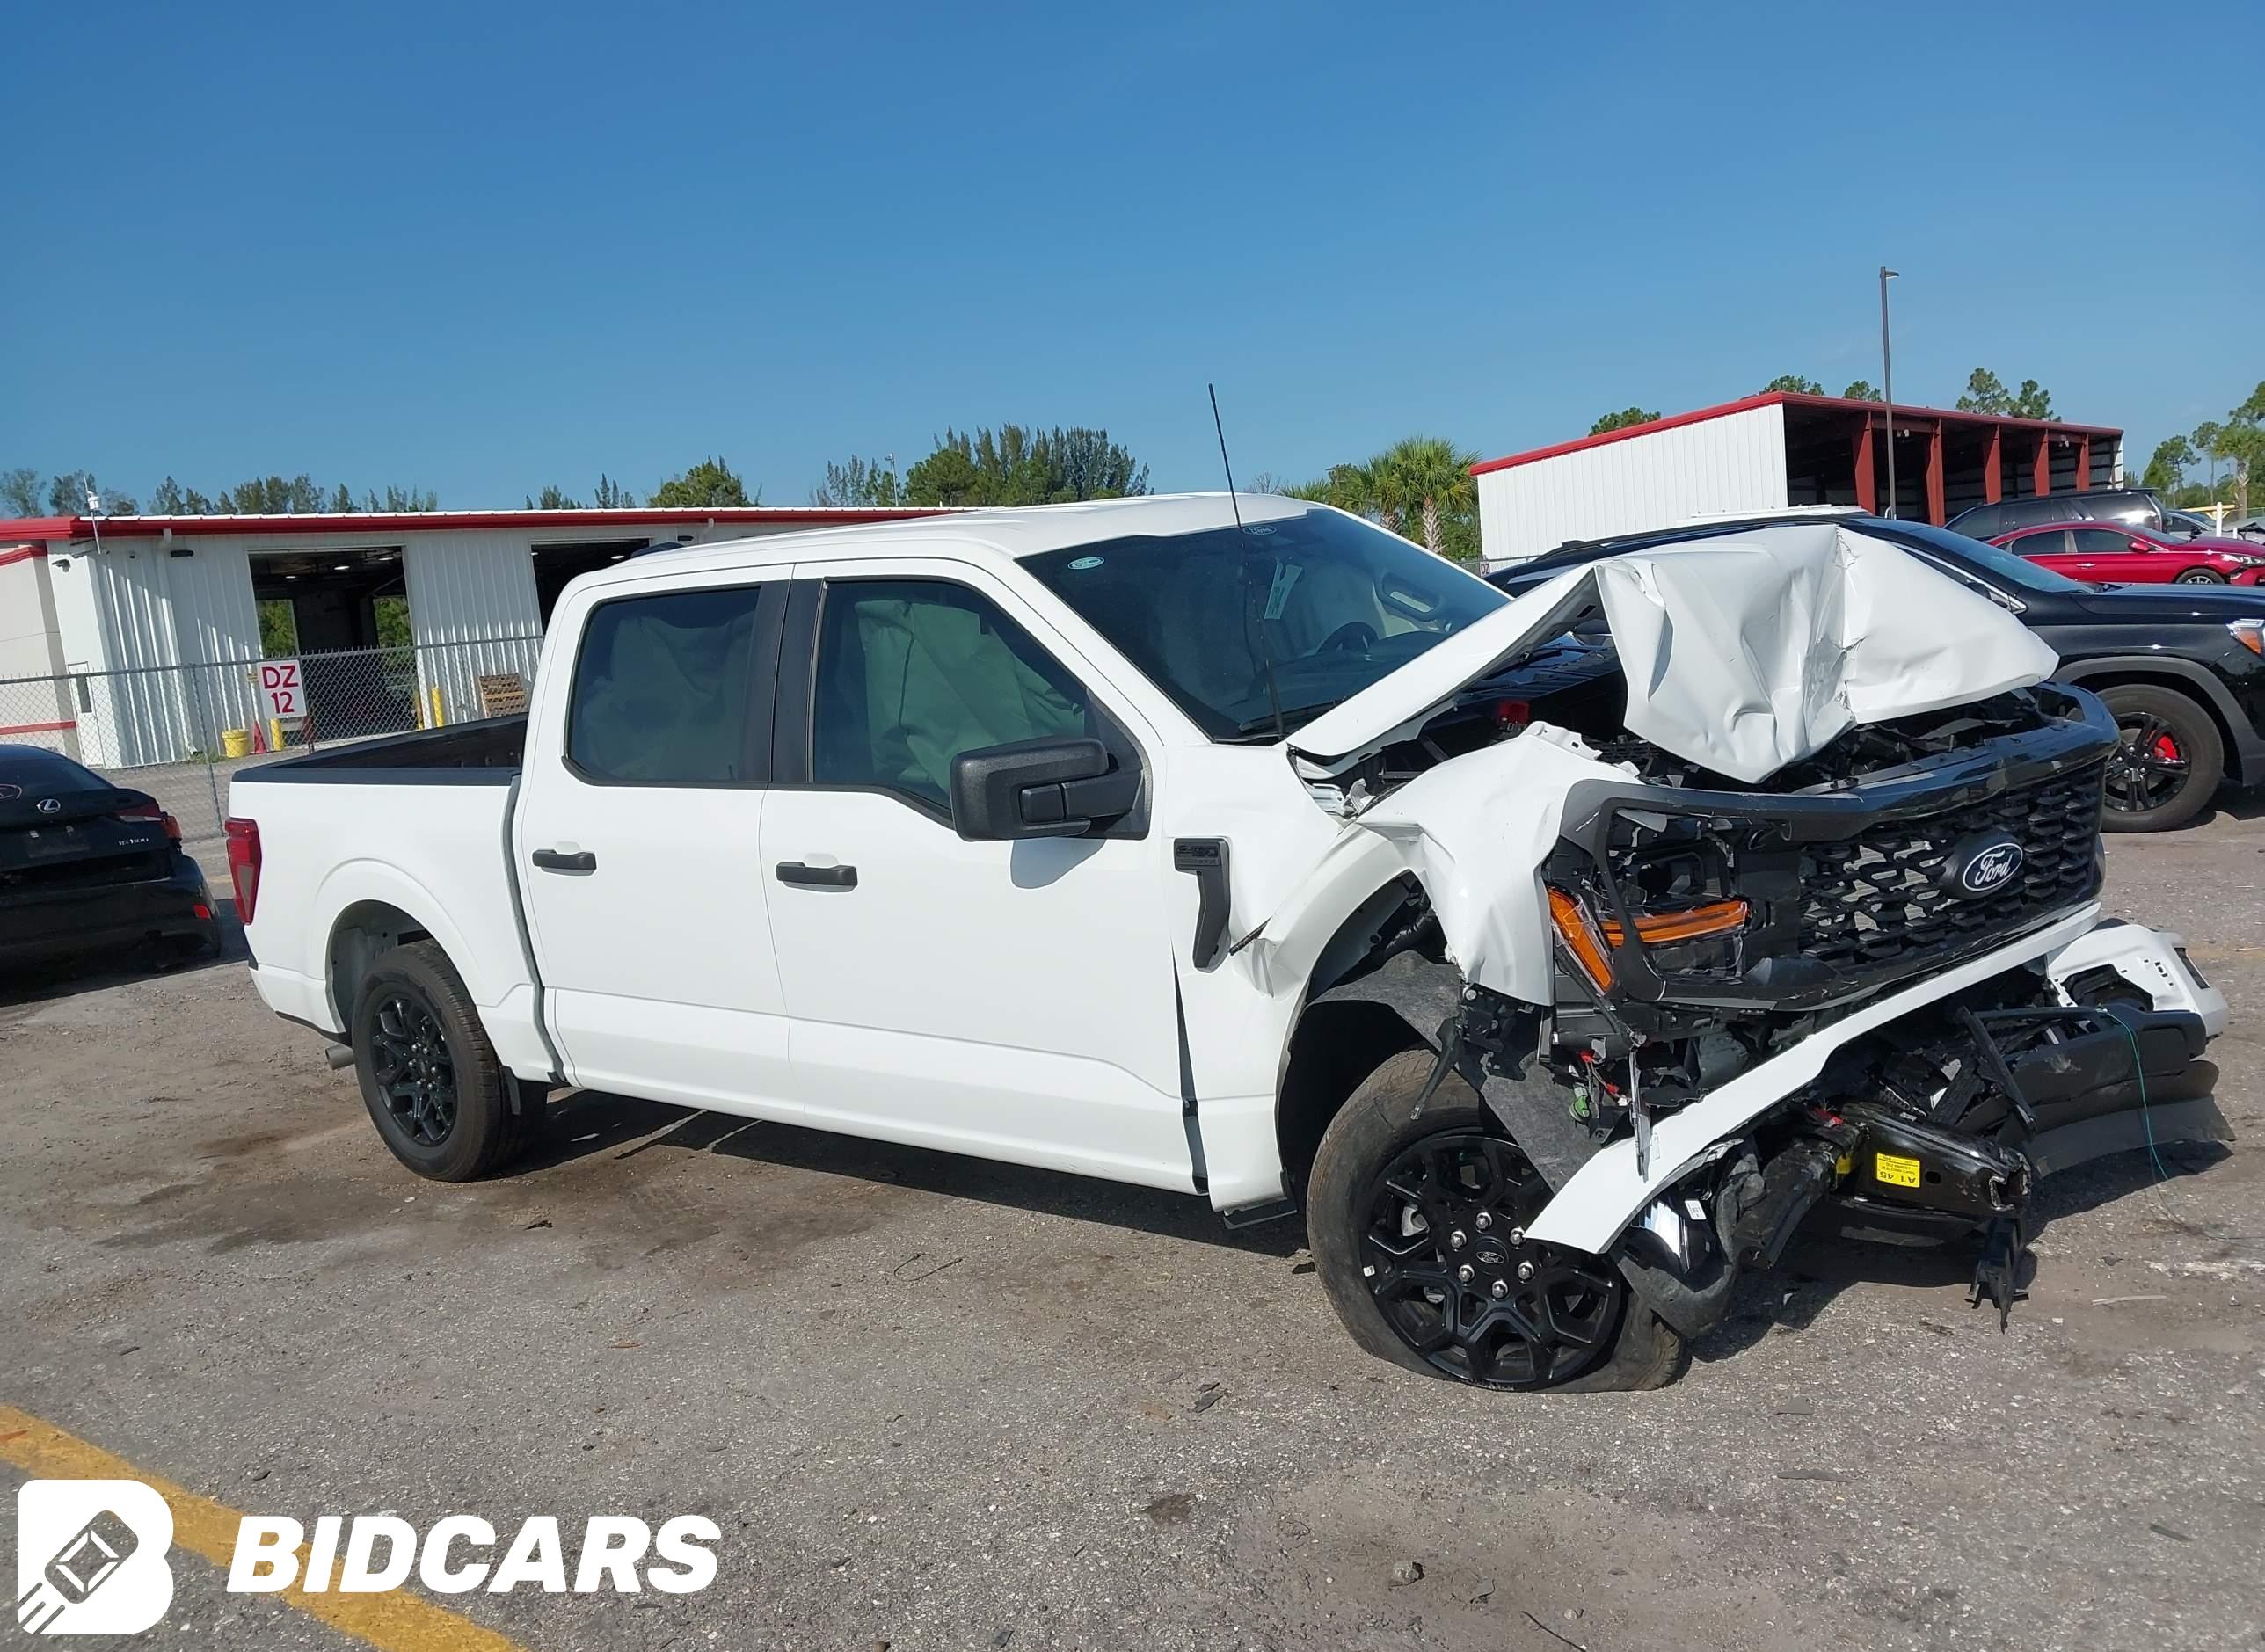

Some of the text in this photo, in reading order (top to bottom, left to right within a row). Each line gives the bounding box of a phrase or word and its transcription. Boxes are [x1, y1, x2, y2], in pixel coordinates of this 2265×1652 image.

[1481, 563, 1490, 575] DZ
[261, 665, 299, 689] DZ
[271, 691, 295, 714] 12
[1974, 849, 2014, 886] Ford
[1880, 1171, 1894, 1180] 45
